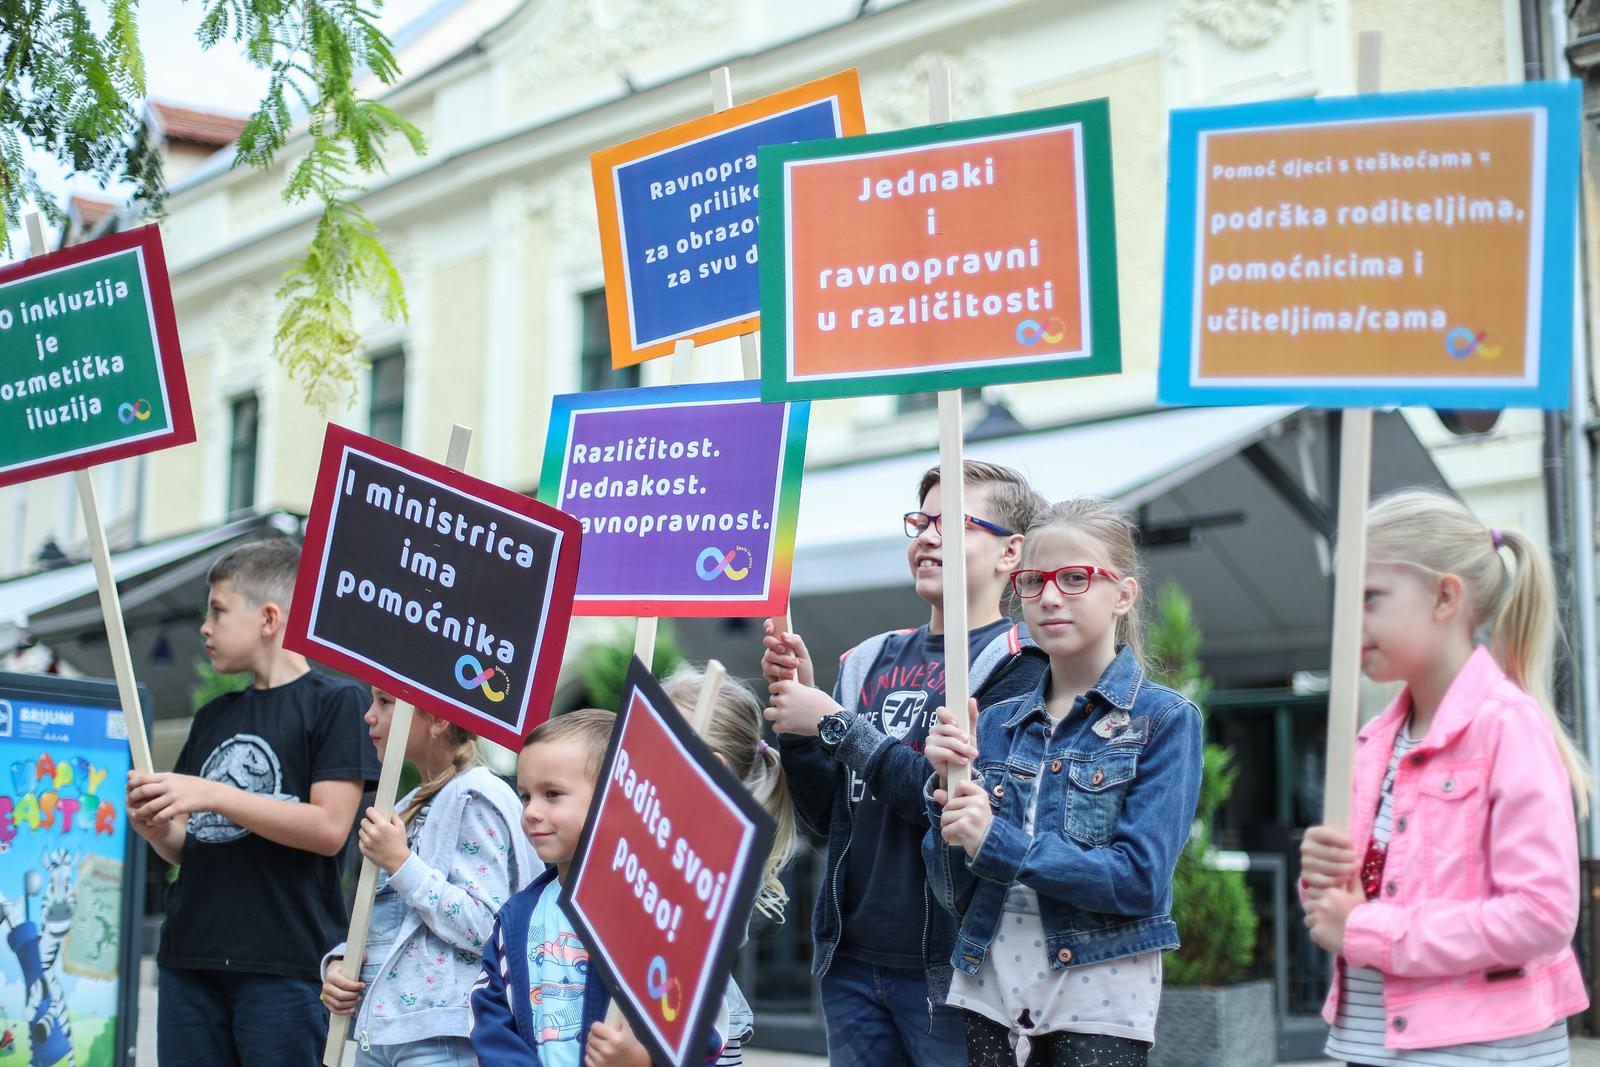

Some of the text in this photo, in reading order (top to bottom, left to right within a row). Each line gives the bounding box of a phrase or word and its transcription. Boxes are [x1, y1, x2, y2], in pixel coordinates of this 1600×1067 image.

[858, 157, 994, 202] Jednaki
[1212, 160, 1277, 180] Pomoć
[1282, 156, 1333, 180] djeci
[1338, 160, 1350, 173] s
[1355, 149, 1473, 172] teškoćama
[927, 208, 936, 235] i
[1210, 196, 1525, 235] podrška roditeljima,
[645, 215, 759, 264] za obrazo
[667, 269, 691, 288] za
[698, 254, 737, 279] svu
[819, 238, 1039, 284] ravnopravni
[1208, 250, 1424, 286] pomoćnicima i
[19, 278, 129, 324] inkluzija
[817, 311, 836, 331] u
[851, 281, 1054, 329] različitosti
[1207, 304, 1448, 336] učiteljima/cama
[34, 333, 59, 361] je
[0, 354, 125, 401] ozmetička
[25, 394, 102, 430] iluzija
[572, 436, 721, 464] Različitost.
[566, 474, 707, 500] Jednakost.
[344, 468, 535, 568] I ministrica
[569, 509, 770, 538] avnopravnost.
[400, 538, 457, 588] ima
[335, 570, 515, 664] pomoćnika
[614, 747, 727, 921] Radite svoj
[612, 837, 682, 943] posao!
